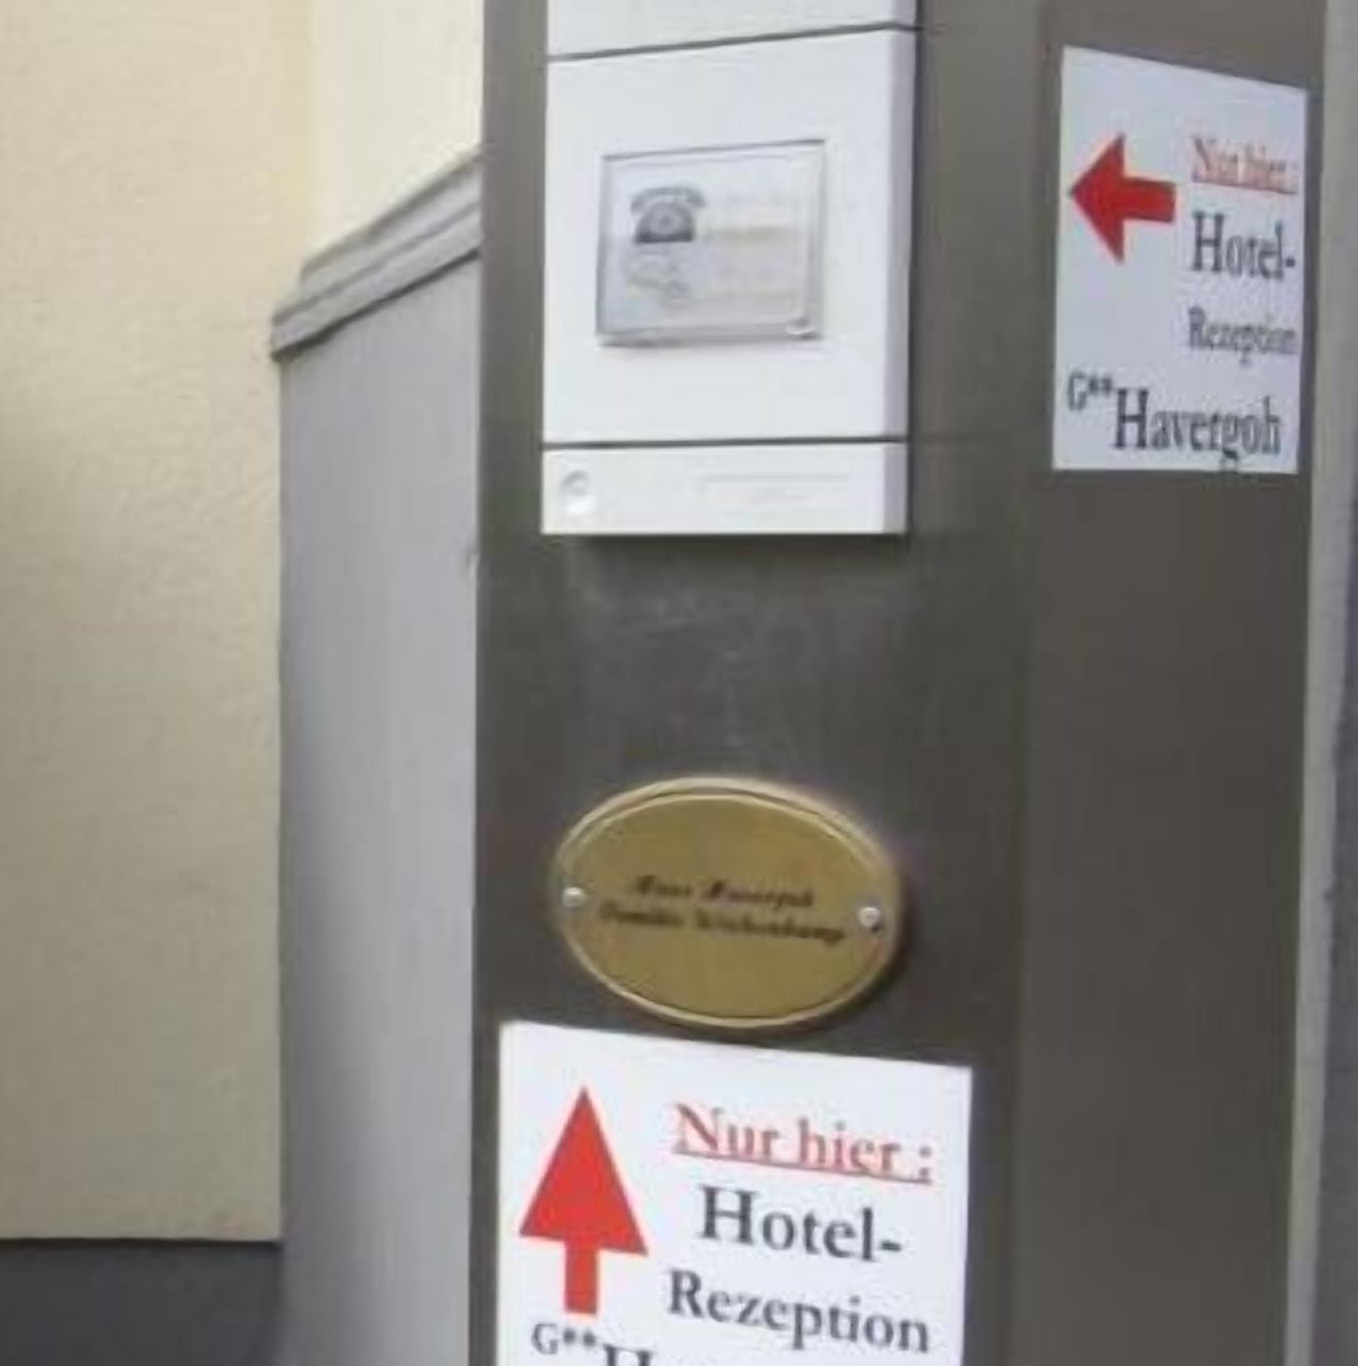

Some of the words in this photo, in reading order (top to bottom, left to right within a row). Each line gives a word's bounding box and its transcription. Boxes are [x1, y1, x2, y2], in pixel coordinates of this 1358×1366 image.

[1192, 210, 1297, 280] Hotel-
[673, 1102, 778, 1161] Nur
[796, 1117, 902, 1176] hier
[698, 1185, 902, 1263] Hotel-
[666, 1268, 930, 1353] Rezeption
